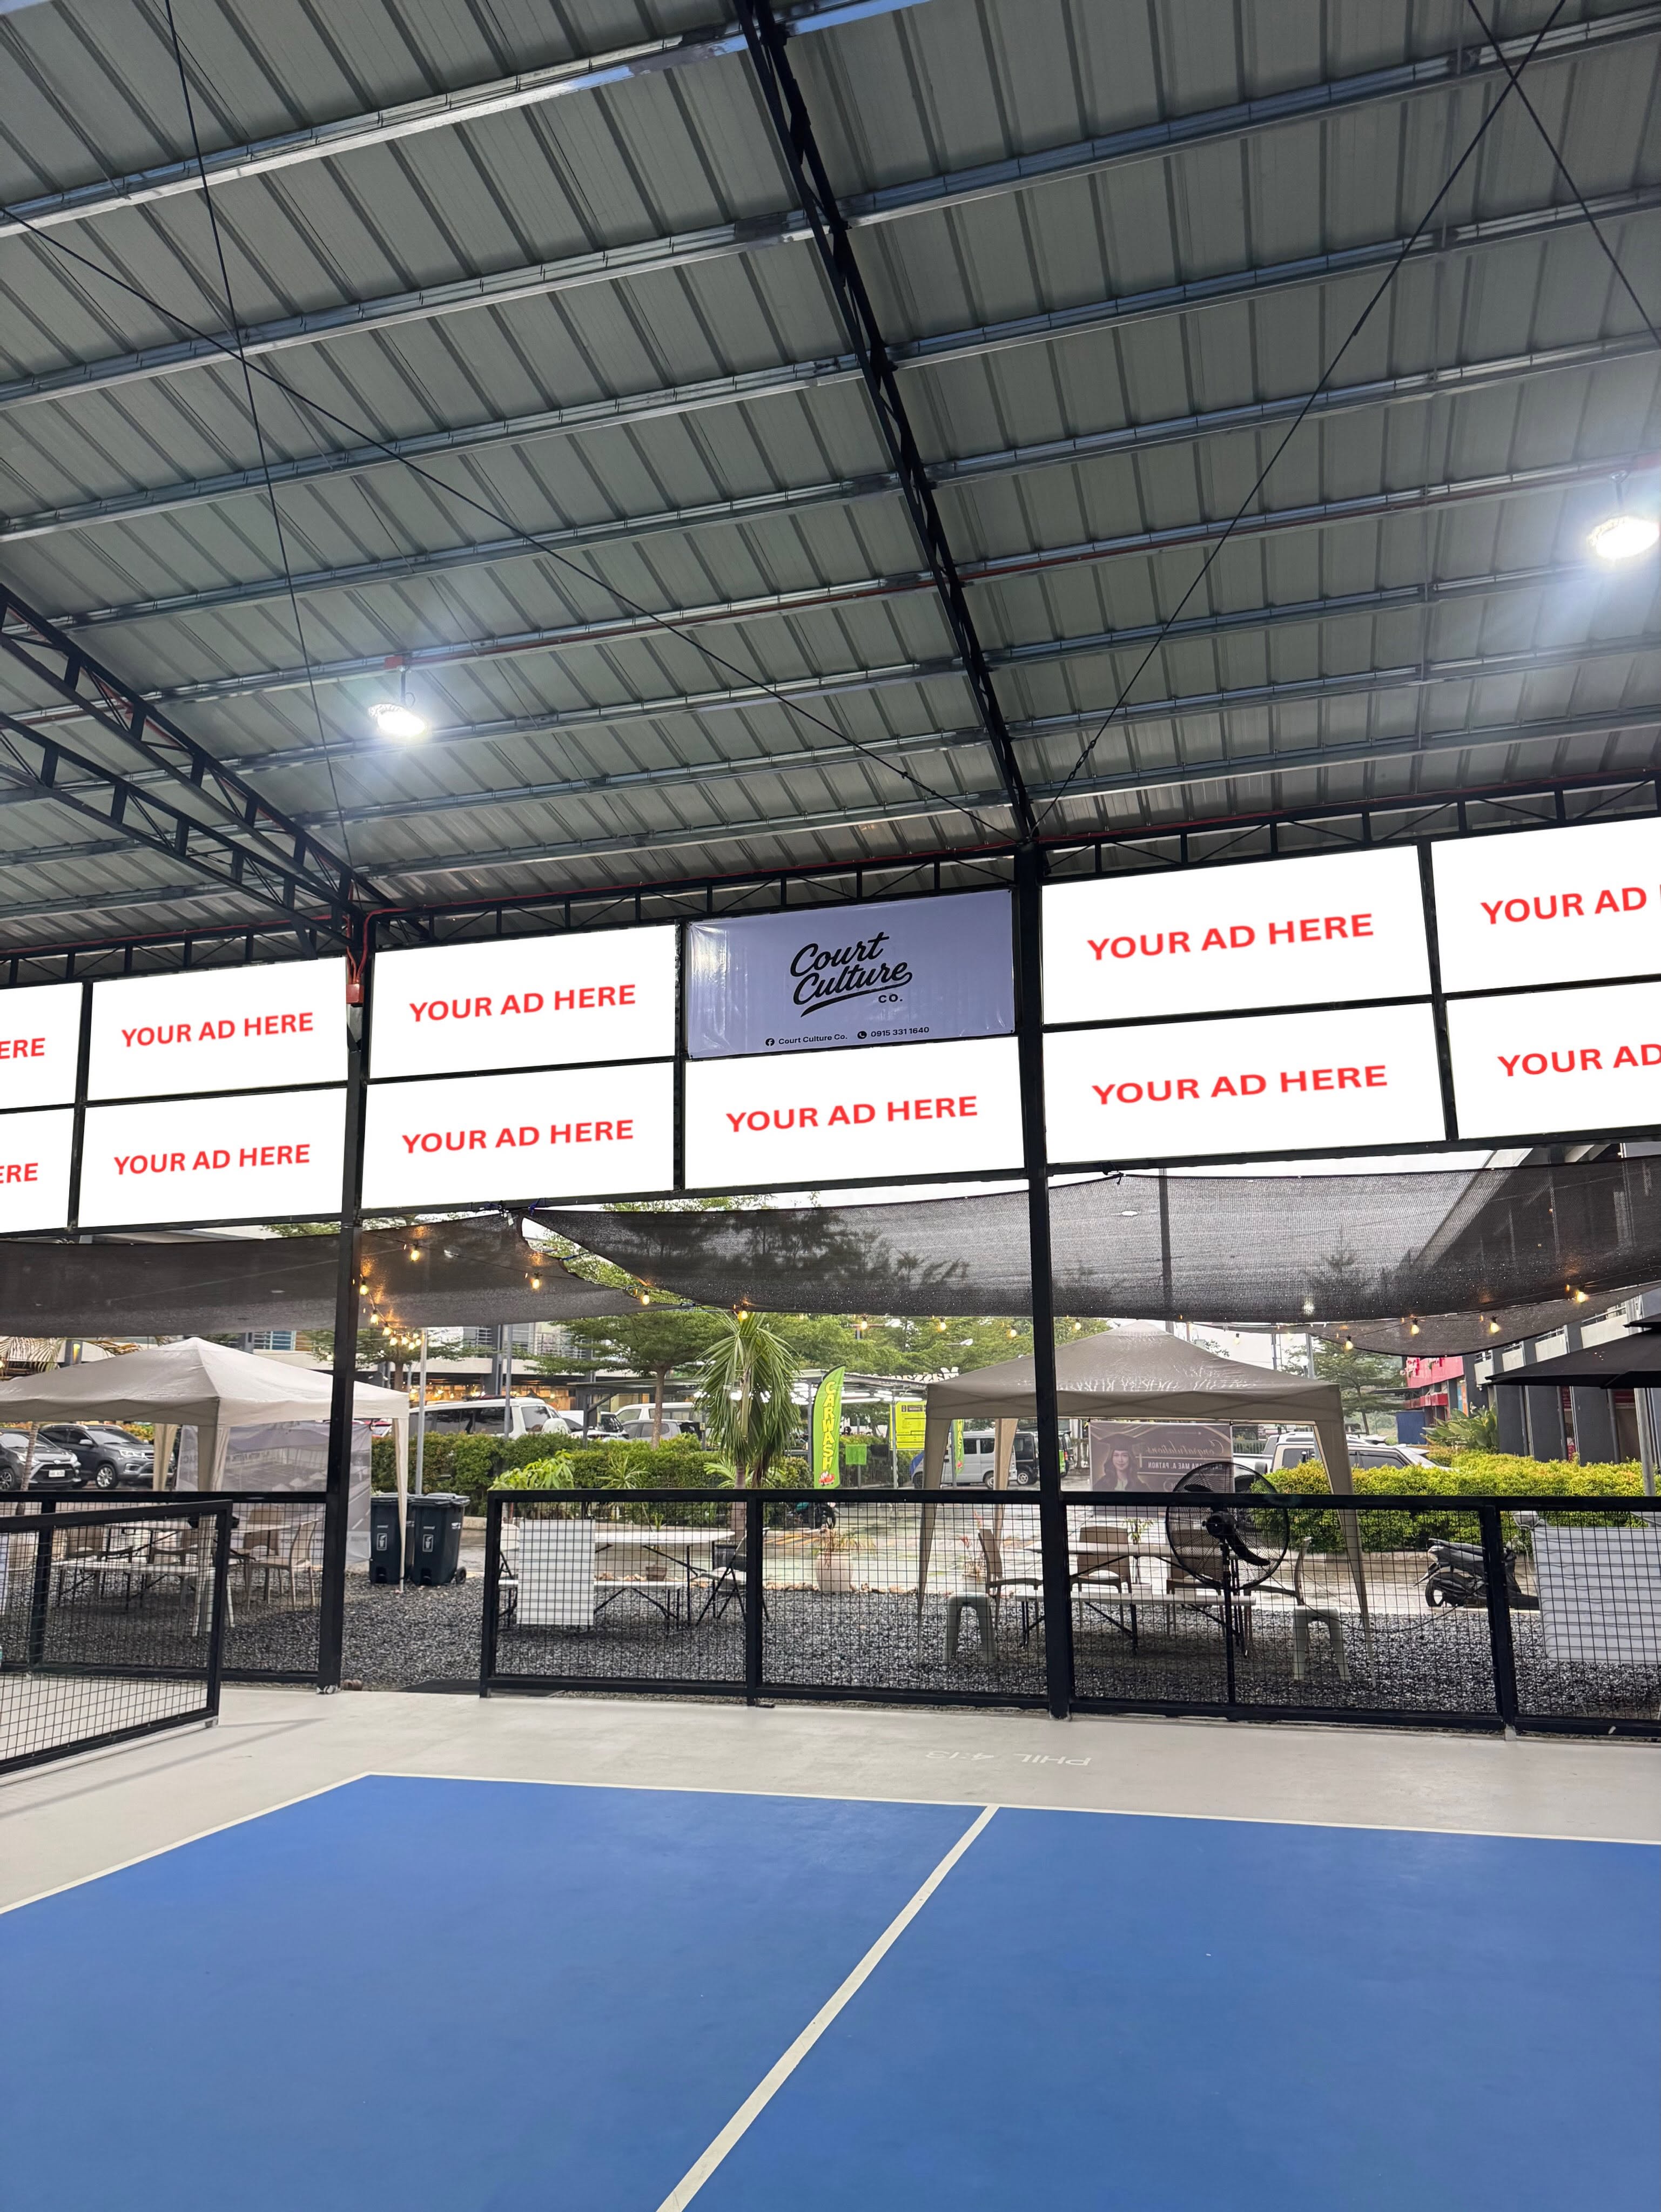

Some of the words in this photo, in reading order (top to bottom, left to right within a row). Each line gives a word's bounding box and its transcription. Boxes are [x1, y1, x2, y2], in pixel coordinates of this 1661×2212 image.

[1481, 893, 1584, 925] YOUR
[1595, 887, 1647, 914] AD
[1087, 931, 1191, 961] YOUR
[1201, 925, 1255, 951] AD
[1268, 913, 1374, 945] HERE
[790, 932, 890, 977] Court
[409, 997, 492, 1022] YOUR
[501, 993, 544, 1015] AD
[554, 984, 636, 1010] HERE
[793, 962, 913, 1011] Culture
[878, 993, 903, 1003] CO.
[122, 1023, 191, 1047] YOUR
[198, 1020, 236, 1041] AD
[244, 1012, 313, 1037] HERE
[803, 1035, 832, 1043] Culture
[909, 1027, 930, 1035] 1640
[0, 1037, 45, 1060] ERE
[1497, 1048, 1603, 1077] YOUR
[1613, 1043, 1661, 1068] AD
[1092, 1078, 1200, 1105] YOUR
[1211, 1074, 1267, 1098] AD
[1280, 1065, 1388, 1093] HERE
[726, 1108, 818, 1132] YOUR
[828, 1103, 876, 1126] AD
[887, 1096, 978, 1122] HERE
[402, 1130, 487, 1154] YOUR
[495, 1127, 540, 1148] AD
[550, 1120, 633, 1144] HERE
[114, 1152, 185, 1175] YOUR
[192, 1150, 231, 1170] AD
[239, 1144, 310, 1167] HERE
[822, 1380, 836, 1471] CARWASH
[925, 1750, 995, 1761] 4:13
[1013, 1753, 1092, 1766] PHIL
